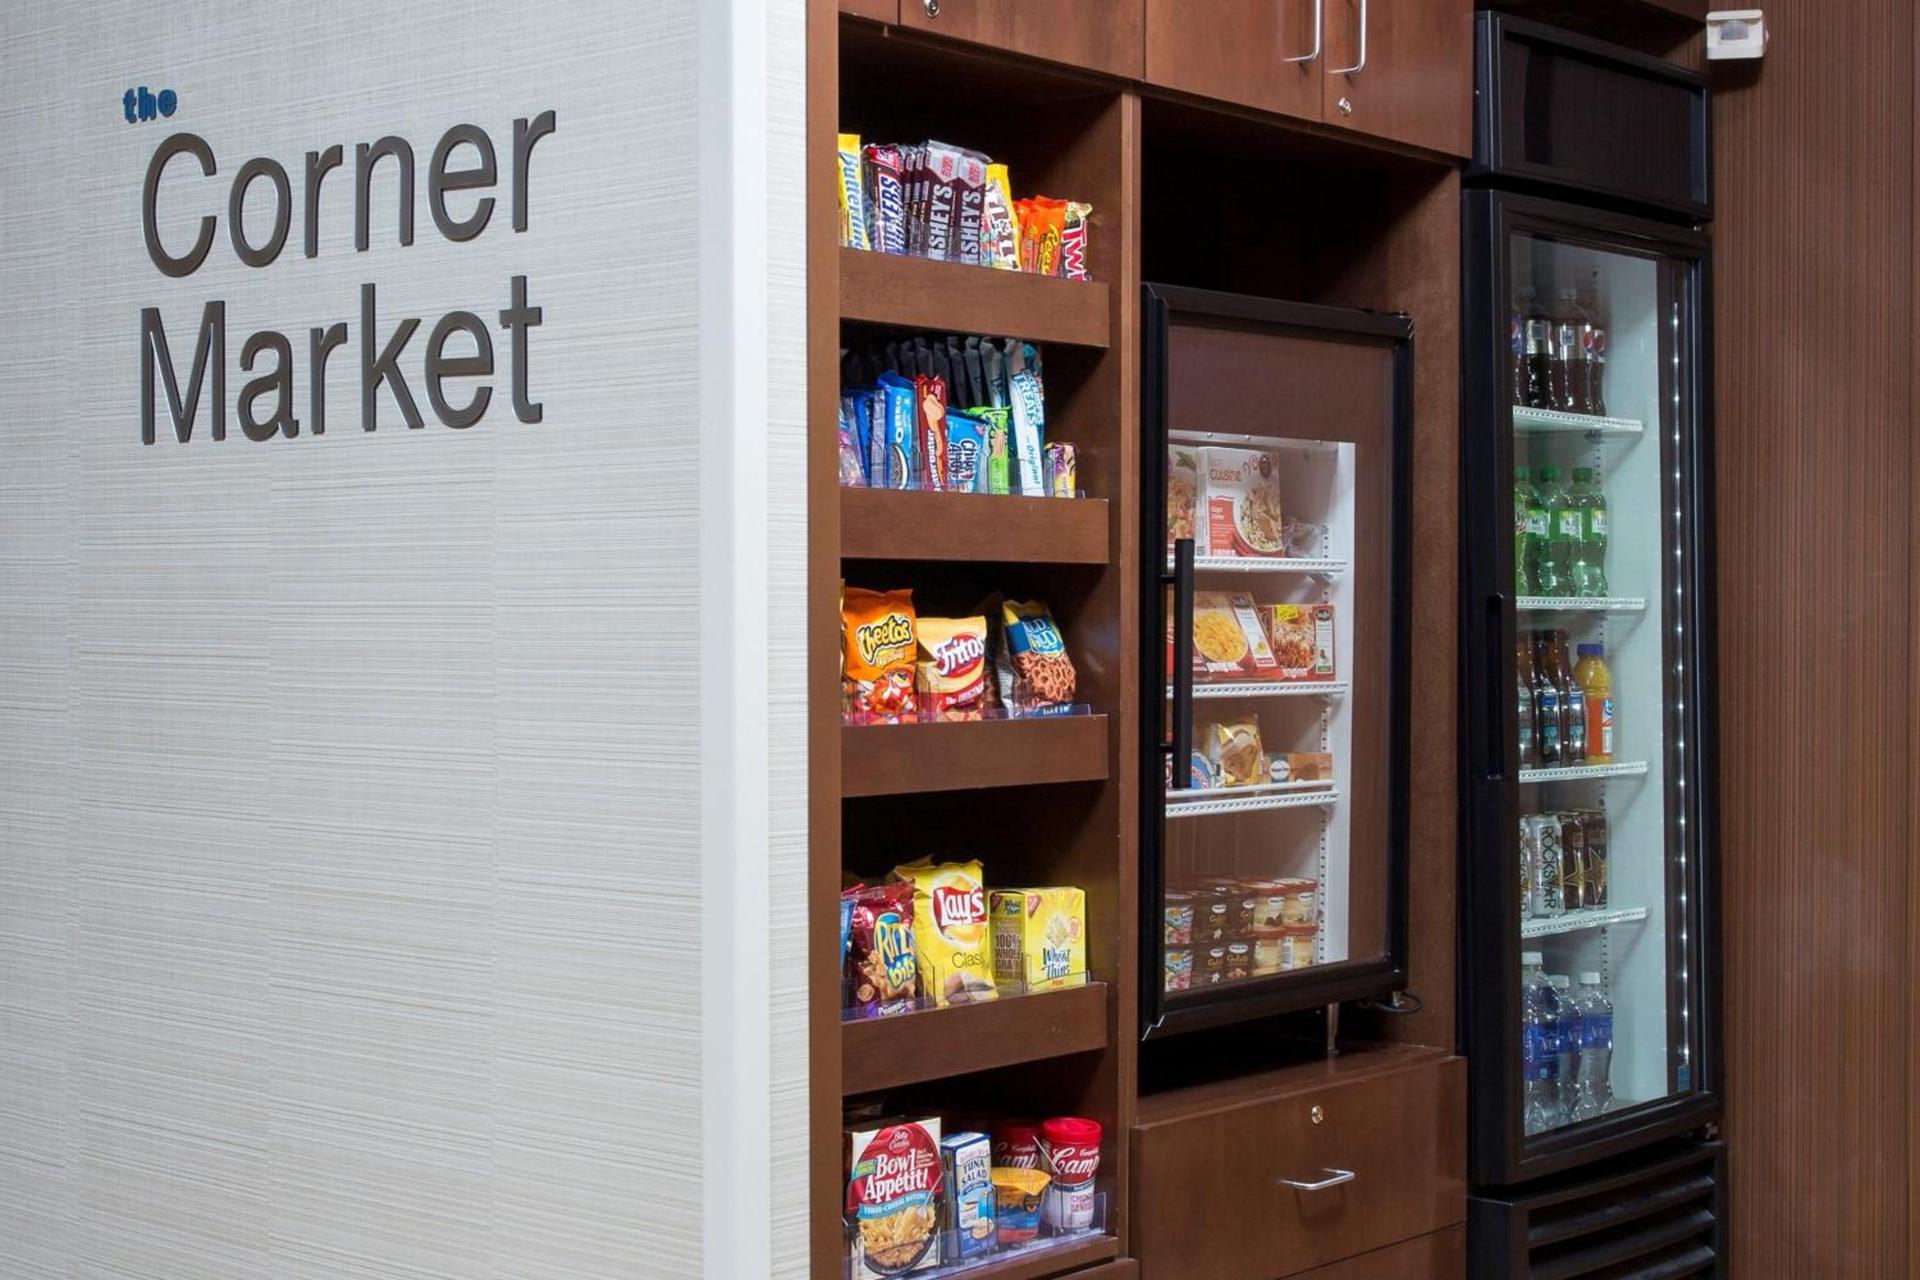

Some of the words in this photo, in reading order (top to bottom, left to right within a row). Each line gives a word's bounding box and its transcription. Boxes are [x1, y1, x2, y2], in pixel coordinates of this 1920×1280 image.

[122, 86, 178, 123] the
[142, 110, 556, 278] Corner
[140, 275, 543, 445] Market
[1012, 372, 1036, 425] TREATS
[894, 395, 904, 443] OREO
[1026, 445, 1041, 485] Original
[858, 614, 912, 663] Cheetos
[934, 636, 984, 677] Fritos
[936, 889, 985, 926] Lay's
[1041, 963, 1071, 981] Thins
[1042, 947, 1070, 965] Wheat
[874, 1148, 916, 1180] Bowl
[962, 1169, 988, 1183] SALAD
[963, 1158, 986, 1174] TUNA
